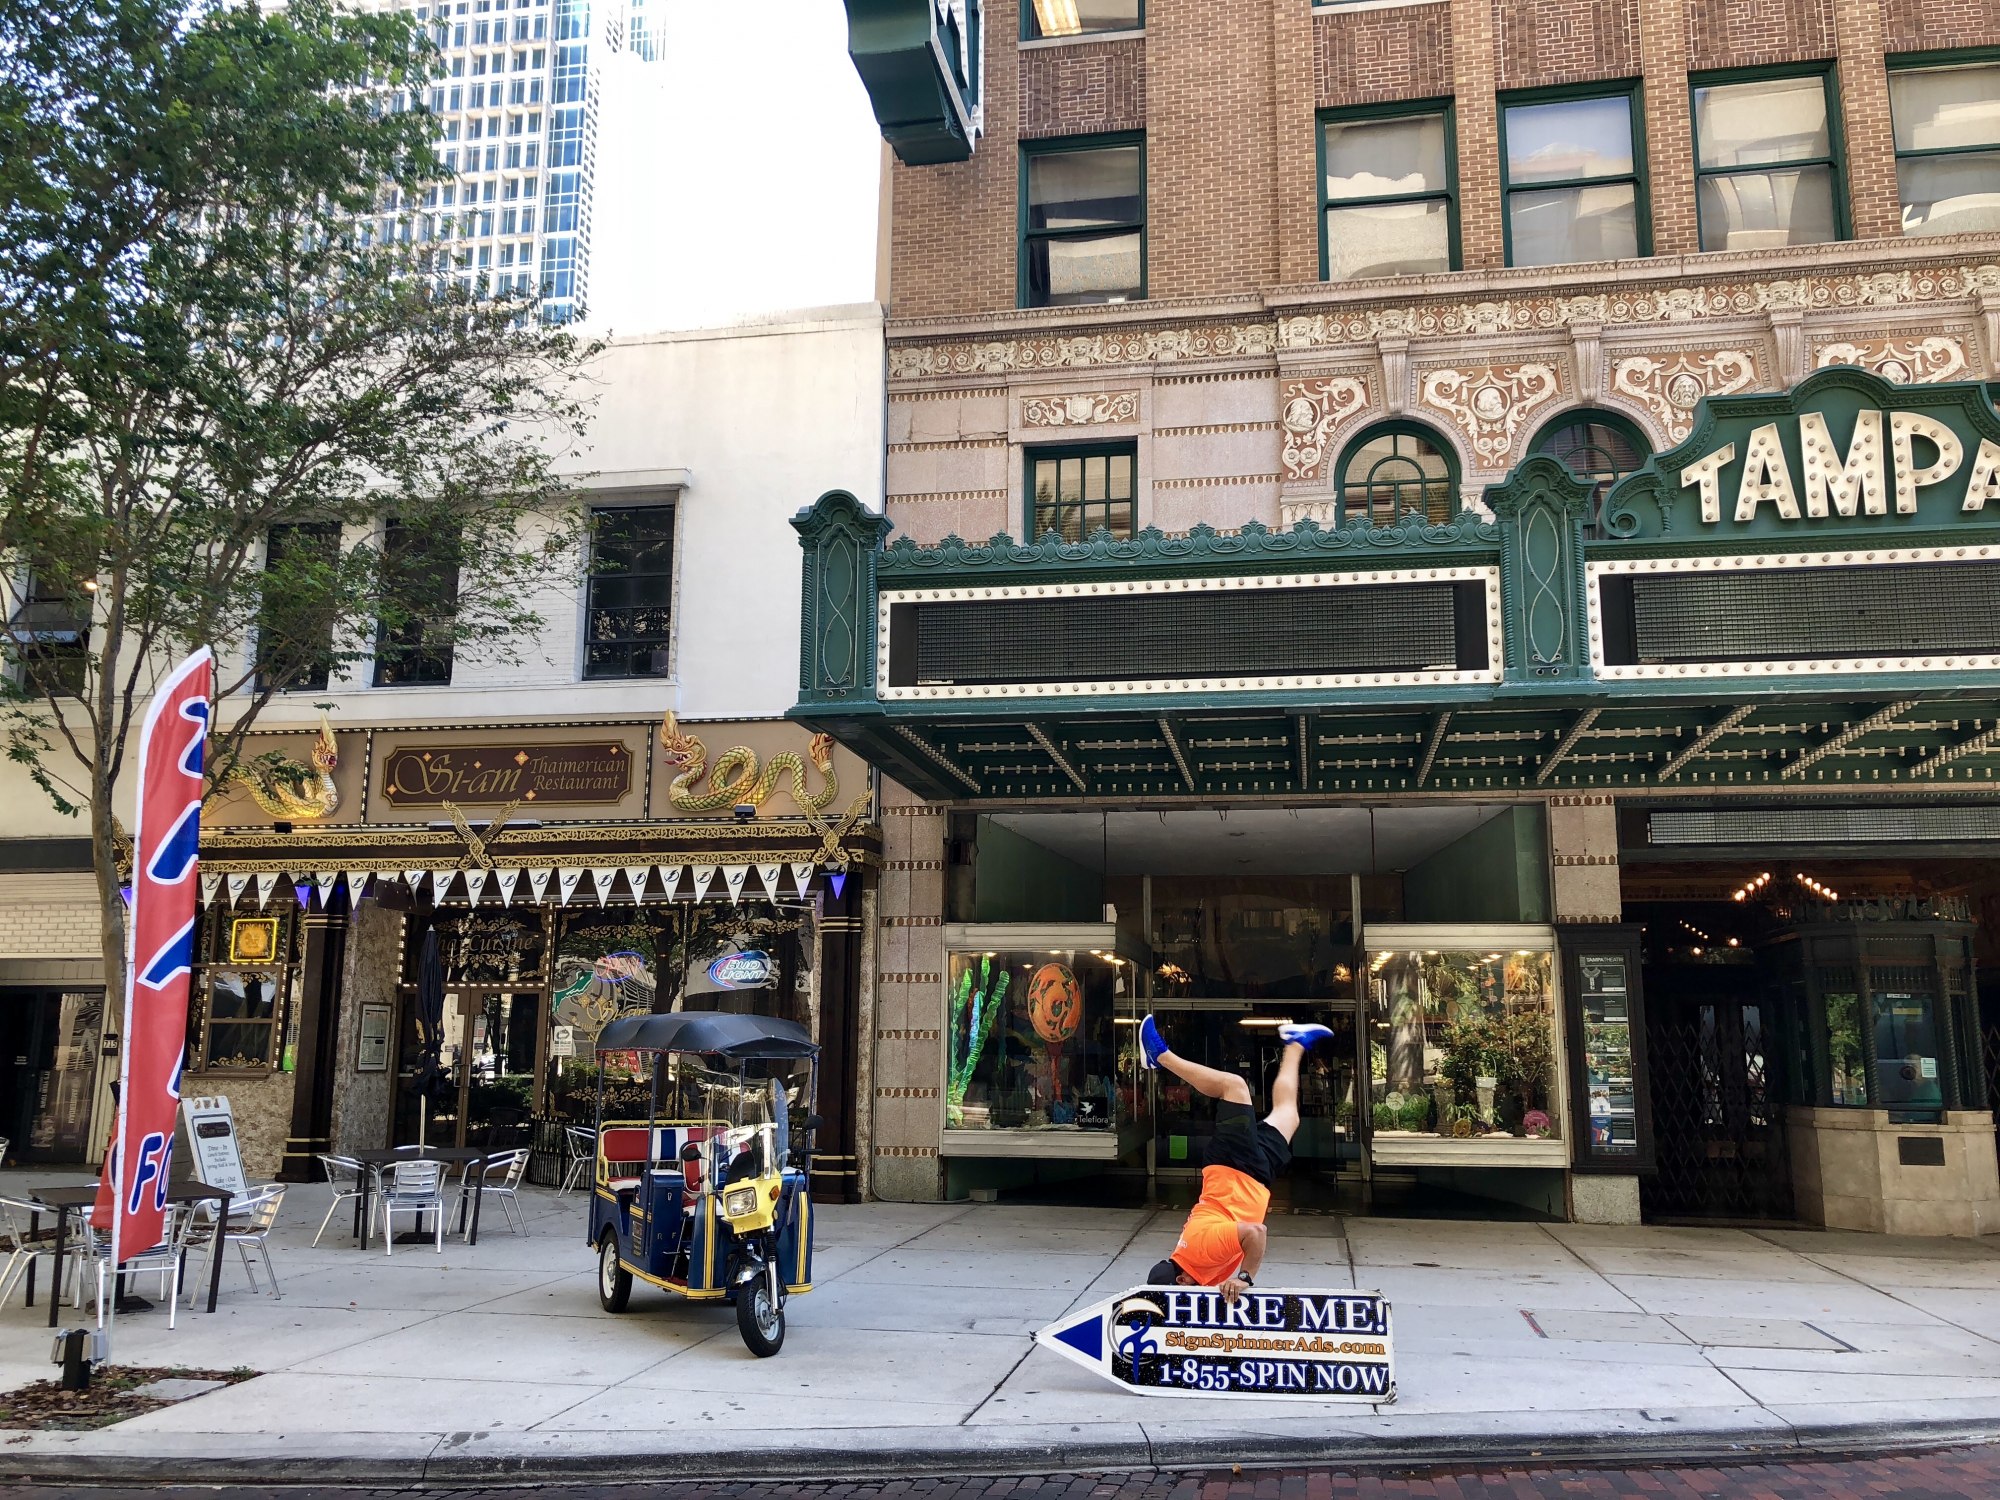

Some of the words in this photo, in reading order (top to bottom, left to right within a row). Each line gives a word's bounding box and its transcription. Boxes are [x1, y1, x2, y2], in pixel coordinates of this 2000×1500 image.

[1680, 409, 2000, 523] TAMPA
[529, 756, 626, 775] Thaimerican
[533, 774, 621, 792] Restaurant
[434, 933, 463, 951] hai
[725, 959, 761, 971] BUD
[718, 969, 765, 981] LIGHT
[103, 1039, 118, 1048] 715
[1077, 1114, 1109, 1124] Teleflora
[1165, 1292, 1285, 1328] HIRE
[1299, 1297, 1385, 1333] ME!
[1165, 1332, 1386, 1355] SignSpinnerAds.com
[1160, 1358, 1309, 1390] 1-855-SPIN
[1315, 1365, 1389, 1391] NOW
